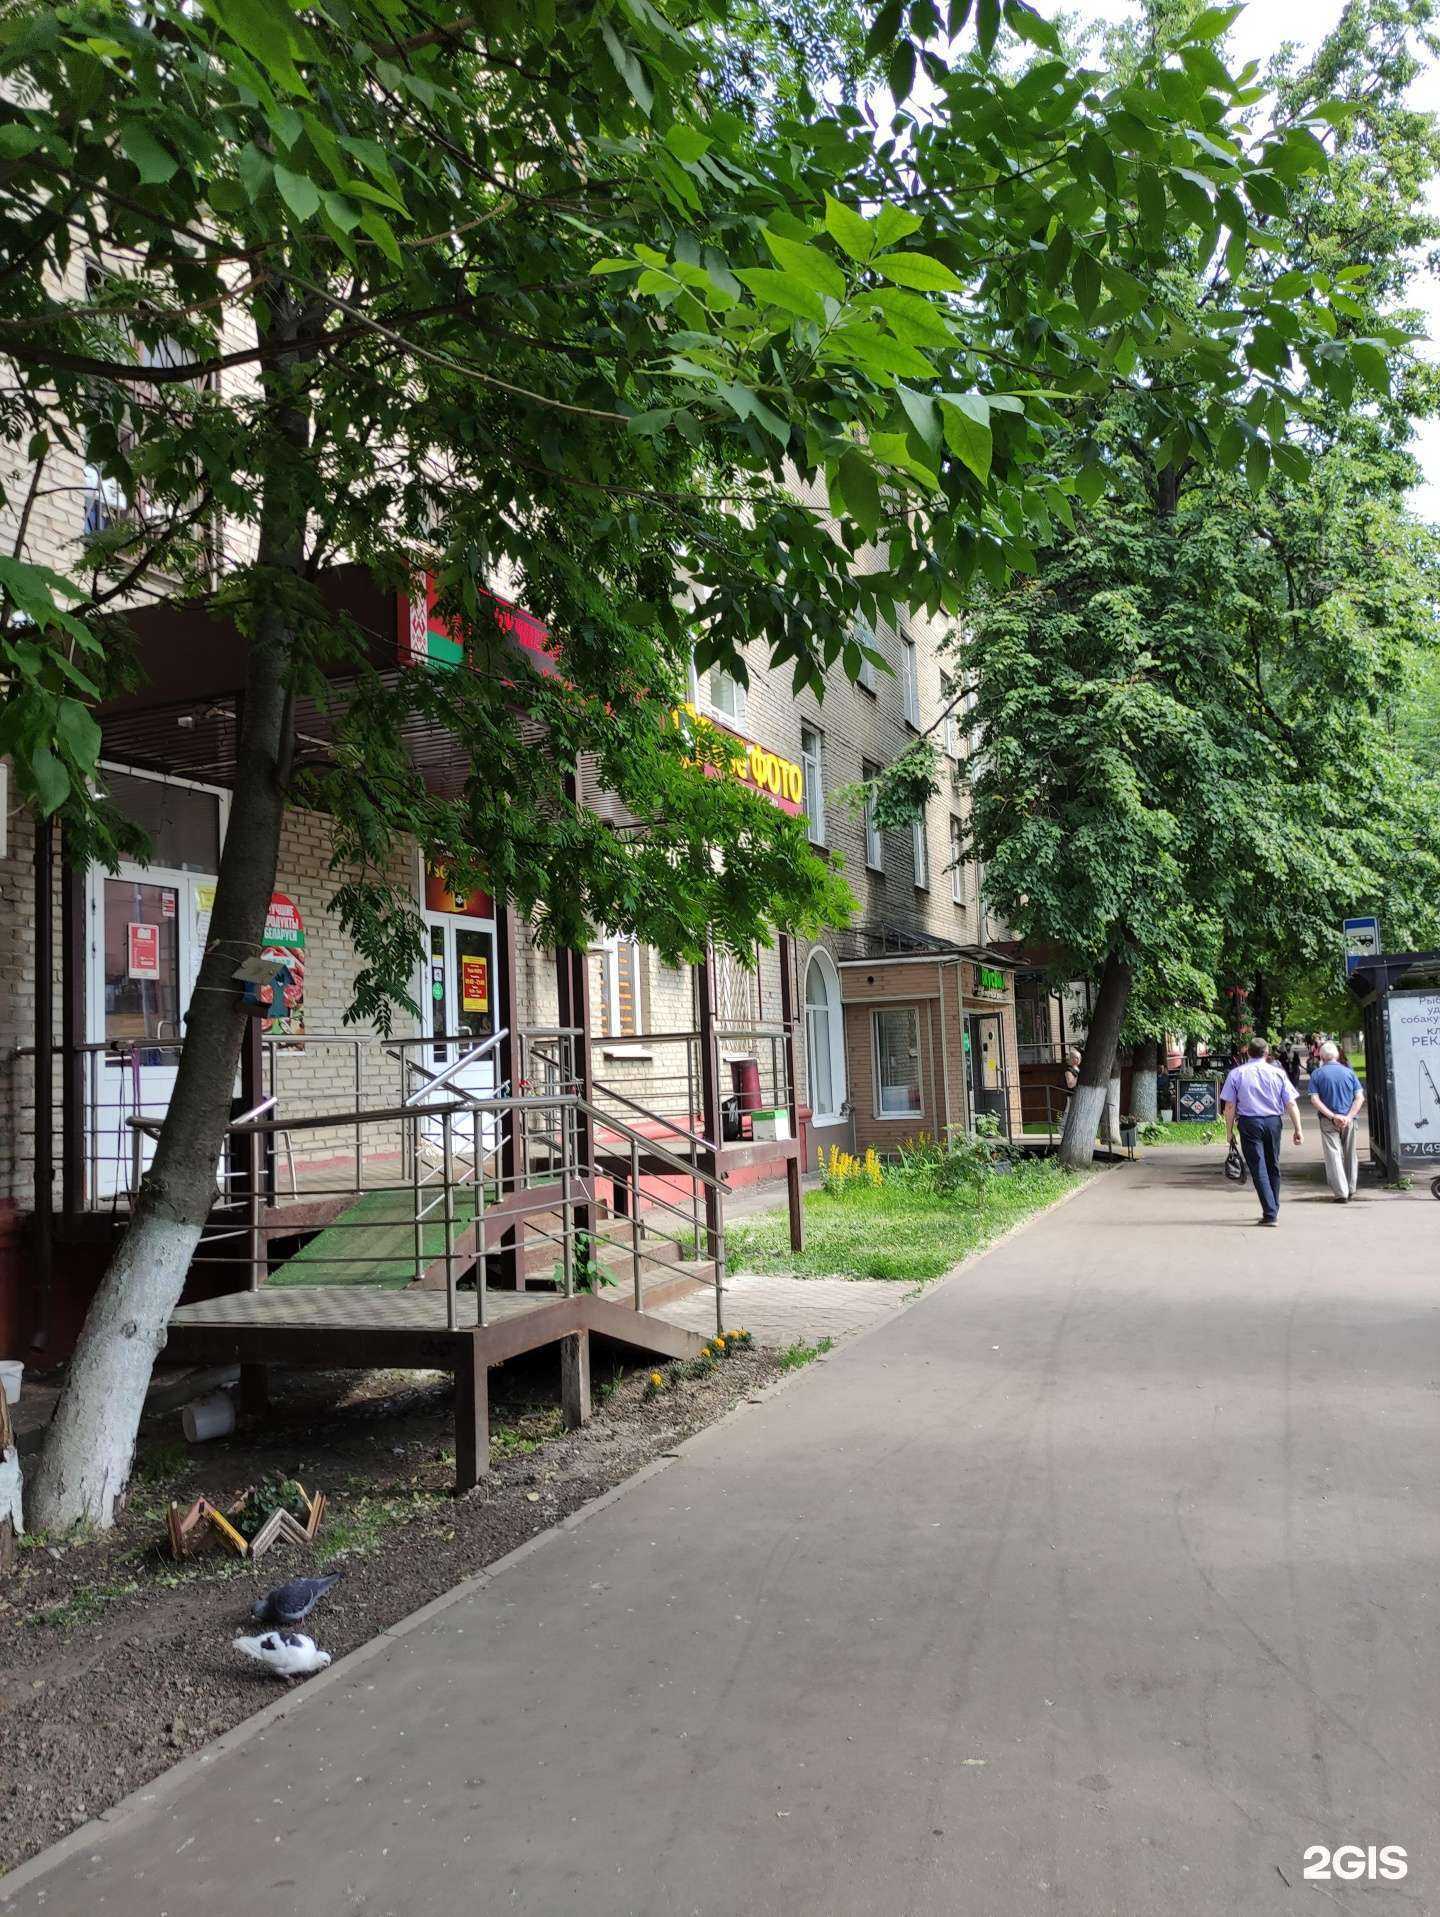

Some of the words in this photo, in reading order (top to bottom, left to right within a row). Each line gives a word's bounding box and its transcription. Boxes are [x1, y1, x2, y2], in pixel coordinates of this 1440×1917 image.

[750, 744, 802, 804] ФОТО
[268, 902, 294, 916] УЧШИЕ
[1400, 1015, 1439, 1025] собаку
